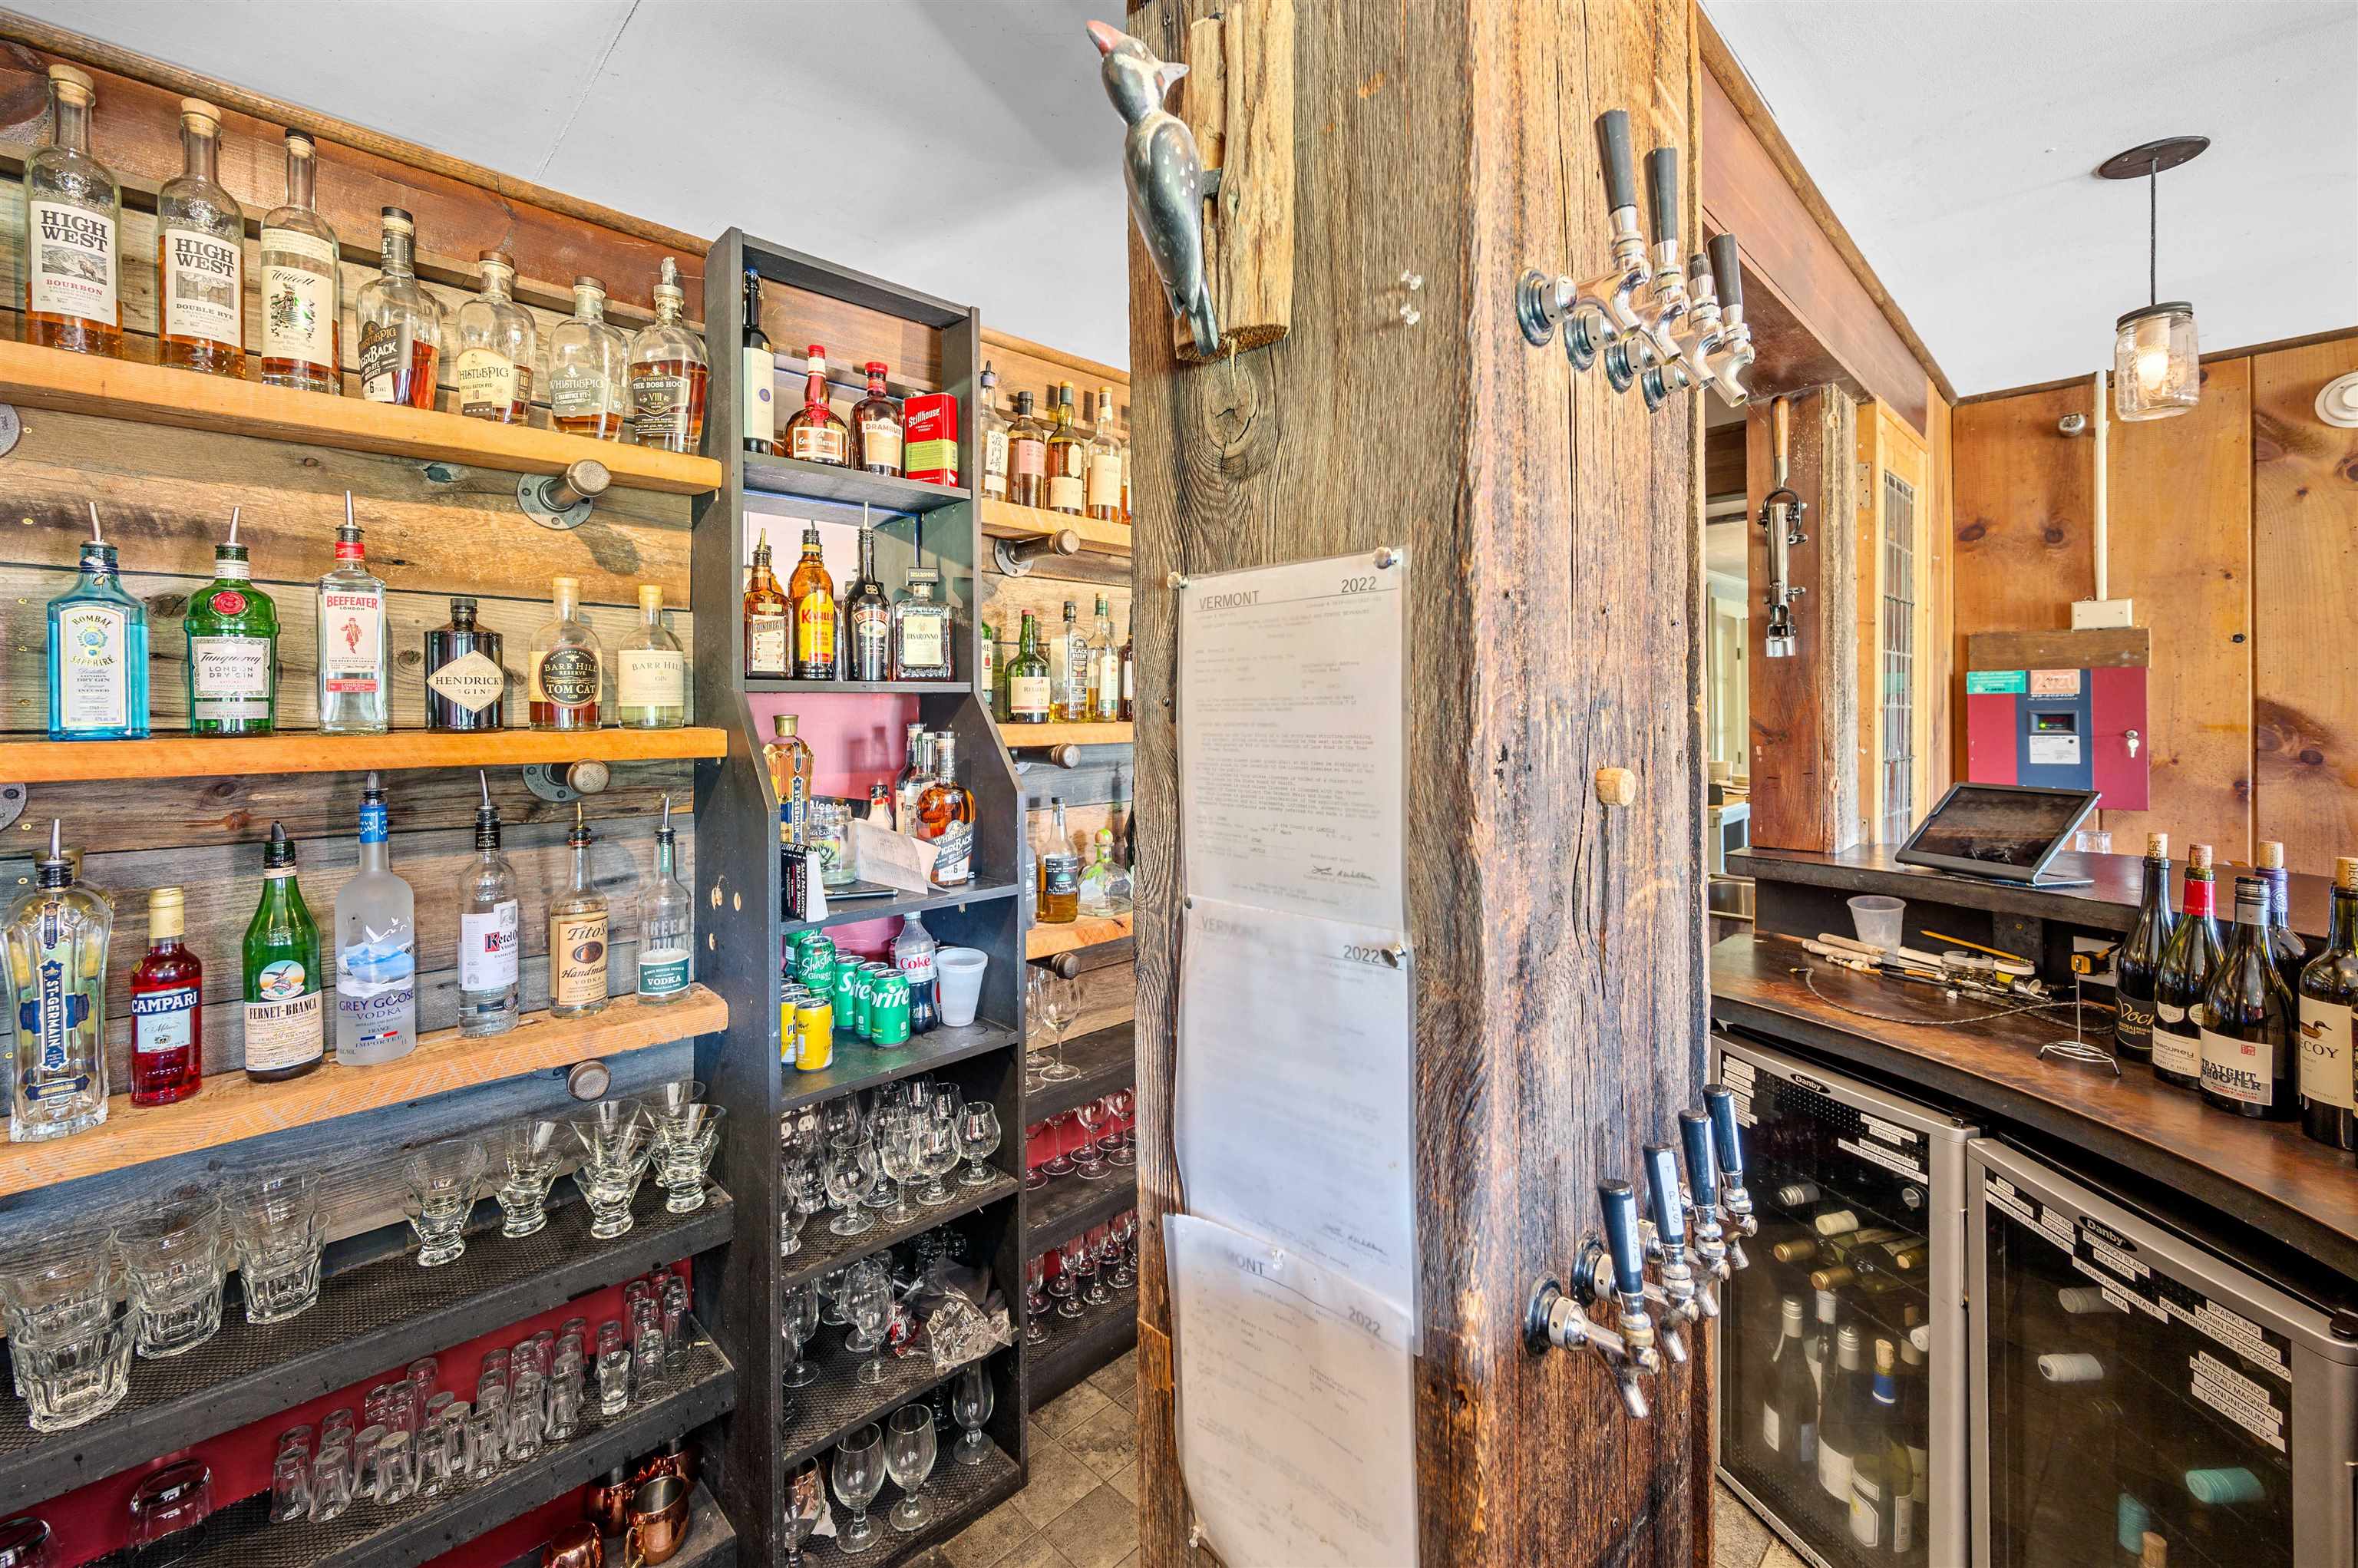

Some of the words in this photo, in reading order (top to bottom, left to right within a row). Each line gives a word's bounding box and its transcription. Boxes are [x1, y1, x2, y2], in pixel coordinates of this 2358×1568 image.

[41, 210, 107, 239] HIGH
[41, 226, 107, 253] WEST
[175, 238, 234, 266] HIGH
[176, 253, 234, 279] WEST
[46, 279, 103, 295] BOURBON
[176, 303, 215, 315] DOUBLE
[218, 311, 234, 320] RYE
[369, 381, 375, 394] 6
[472, 389, 480, 400] 10
[649, 392, 662, 401] VIII
[908, 408, 941, 427] Stillhouse
[326, 596, 378, 610] BEEFEATER
[1199, 590, 1260, 610] VERMONT
[1341, 576, 1377, 593] 2022
[71, 615, 113, 628] BOMBAY
[70, 655, 117, 667] SAPPHIRE
[200, 652, 262, 665] Tanqueray
[544, 662, 573, 672] BARR
[576, 662, 597, 672] HILL
[632, 662, 661, 671] BARR
[664, 661, 682, 672] HILL
[547, 685, 573, 694] TOM
[576, 684, 596, 694] CAT
[953, 864, 958, 873] 6
[567, 923, 606, 941] Tito's
[900, 955, 931, 970] Coke
[1343, 945, 1380, 964] 2022
[575, 976, 603, 985] VODKA
[647, 975, 682, 985] VODKA
[131, 991, 197, 1013] CAMPARI
[249, 998, 317, 1020] FERNET-BRANCA
[339, 1000, 368, 1011] GREY
[373, 989, 414, 1008] GOOSE
[46, 980, 61, 1048] ST-GERMAIN
[356, 1007, 401, 1020] VODKA
[2202, 1058, 2257, 1082] TRAIGHT
[2202, 1068, 2261, 1091] SHOOTER
[1795, 1074, 1821, 1092] Danby
[1871, 1128, 1889, 1138] ZONIN
[1844, 1143, 1861, 1153] PINOT
[1861, 1150, 1877, 1160] GRIS
[1886, 1160, 1905, 1173] OWEN
[1906, 1170, 1919, 1179] ROE
[1861, 1141, 1877, 1151] SANTA
[1879, 1149, 1917, 1167] MARGHERITA
[2010, 1197, 2031, 1214] MIQUEL
[1991, 1197, 2016, 1216] DOMAINE
[2016, 1212, 2025, 1221] DE
[2025, 1218, 2033, 1226] LA
[2033, 1223, 2065, 1247] PREBENDE
[2043, 1219, 2074, 1241] CORVIDAE
[2045, 1209, 2072, 1230] RIESLING
[2086, 1219, 2123, 1246] Danby
[2084, 1232, 2123, 1259] SAUVIGNON
[2124, 1256, 2148, 1274] BLANC
[2095, 1250, 2109, 1265] SEA
[2110, 1259, 2133, 1278] PEARL
[2079, 1263, 2104, 1282] ROUND
[2105, 1276, 2126, 1296] POND
[2128, 1292, 2158, 1315] ESTATE
[2105, 1291, 2127, 1309] AVETA
[1348, 1306, 1382, 1338] 2022
[2208, 1303, 2259, 1335] SPARKLING
[2161, 1299, 2209, 1333] SOMMARIVA
[2211, 1329, 2235, 1348] ROSE
[2237, 1345, 2290, 1379] PROSECCO
[2198, 1309, 2224, 1330] ZONIN
[2226, 1326, 2277, 1358] PROSECCO
[2201, 1354, 2228, 1377] WHITE
[2231, 1372, 2267, 1399] BLENDS
[2191, 1360, 2231, 1390] CHATEAU
[2234, 1386, 2280, 1420] MAGNEAU
[2204, 1381, 2266, 1424] CONUNDRUM
[2201, 1391, 2237, 1420] TABLAS
[2239, 1415, 2273, 1442] CREEK
